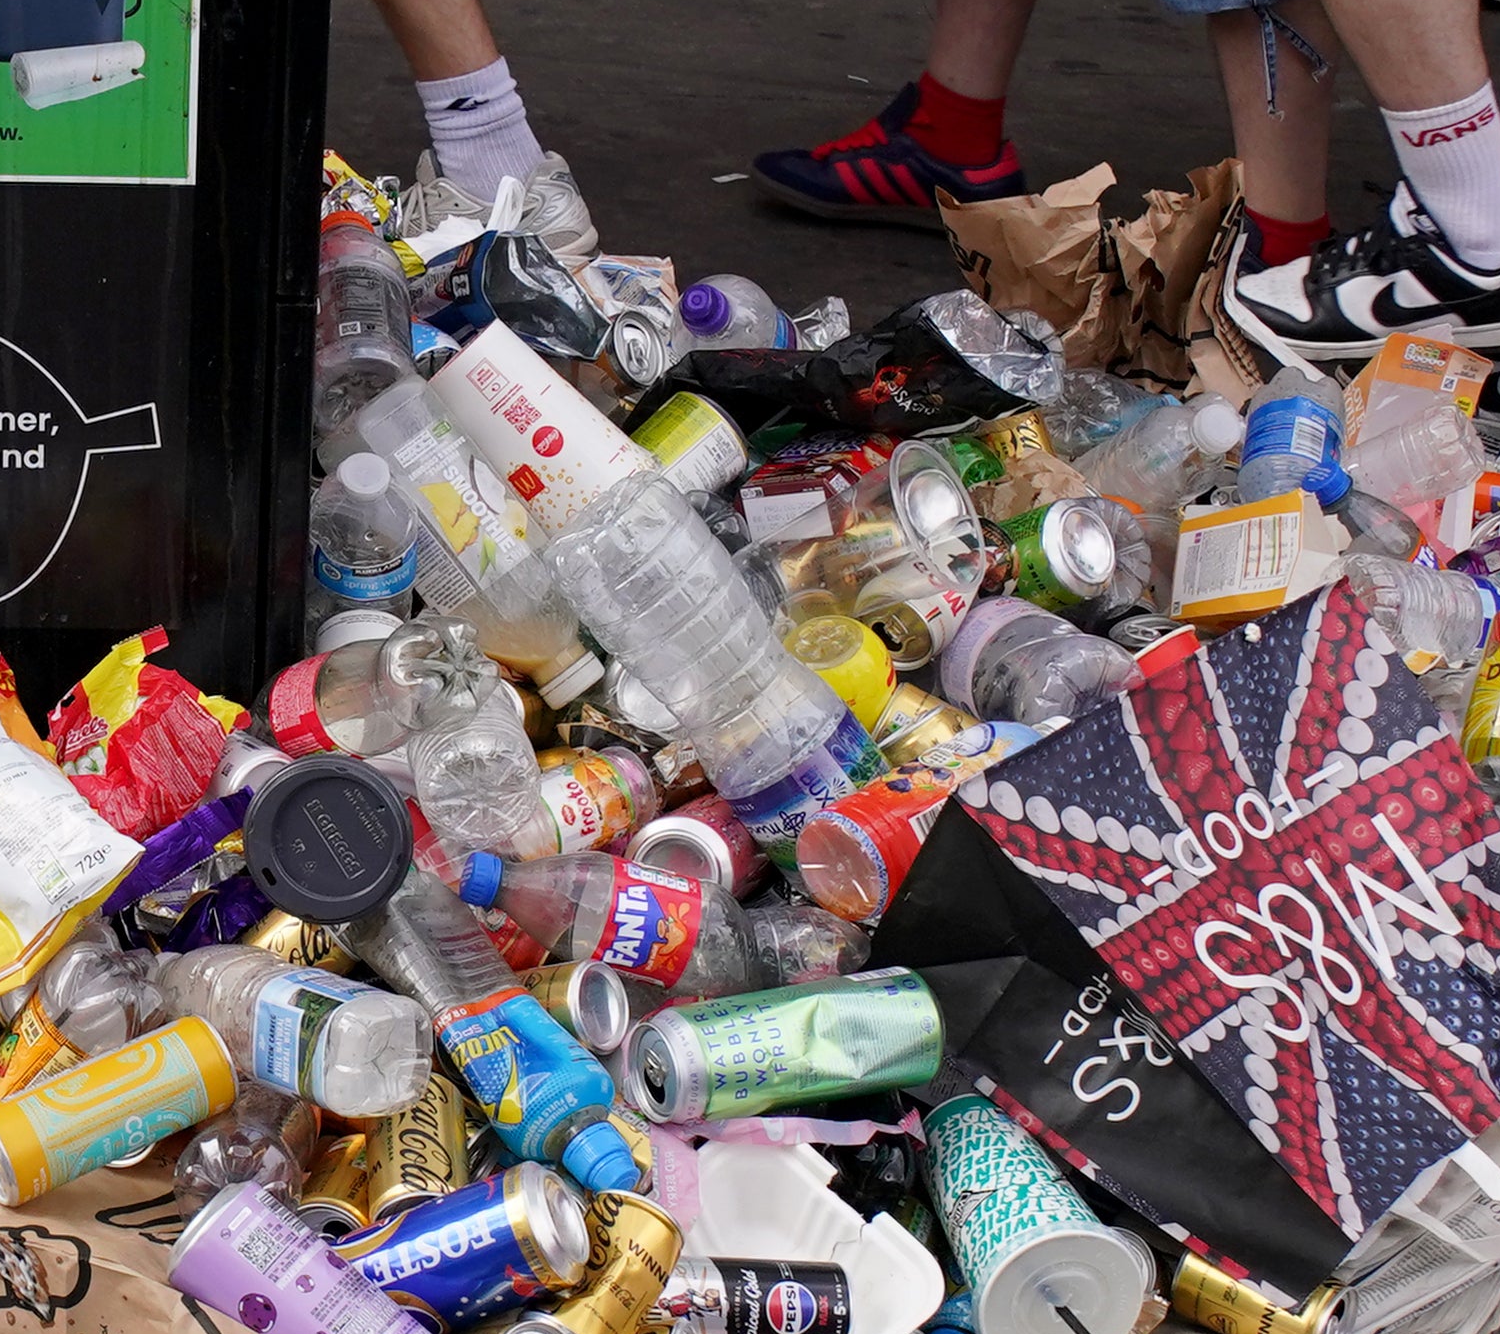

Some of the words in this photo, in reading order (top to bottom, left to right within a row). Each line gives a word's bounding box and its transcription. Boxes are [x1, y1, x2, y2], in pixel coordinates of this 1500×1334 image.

[567, 780, 597, 837] Frooto
[1173, 772, 1304, 883] FOOD
[604, 885, 649, 967] FANTA
[1196, 813, 1467, 1045] M&S
[746, 1269, 763, 1298] Gold
[785, 1283, 797, 1334] PEPSI
[819, 1295, 829, 1326] MAX
